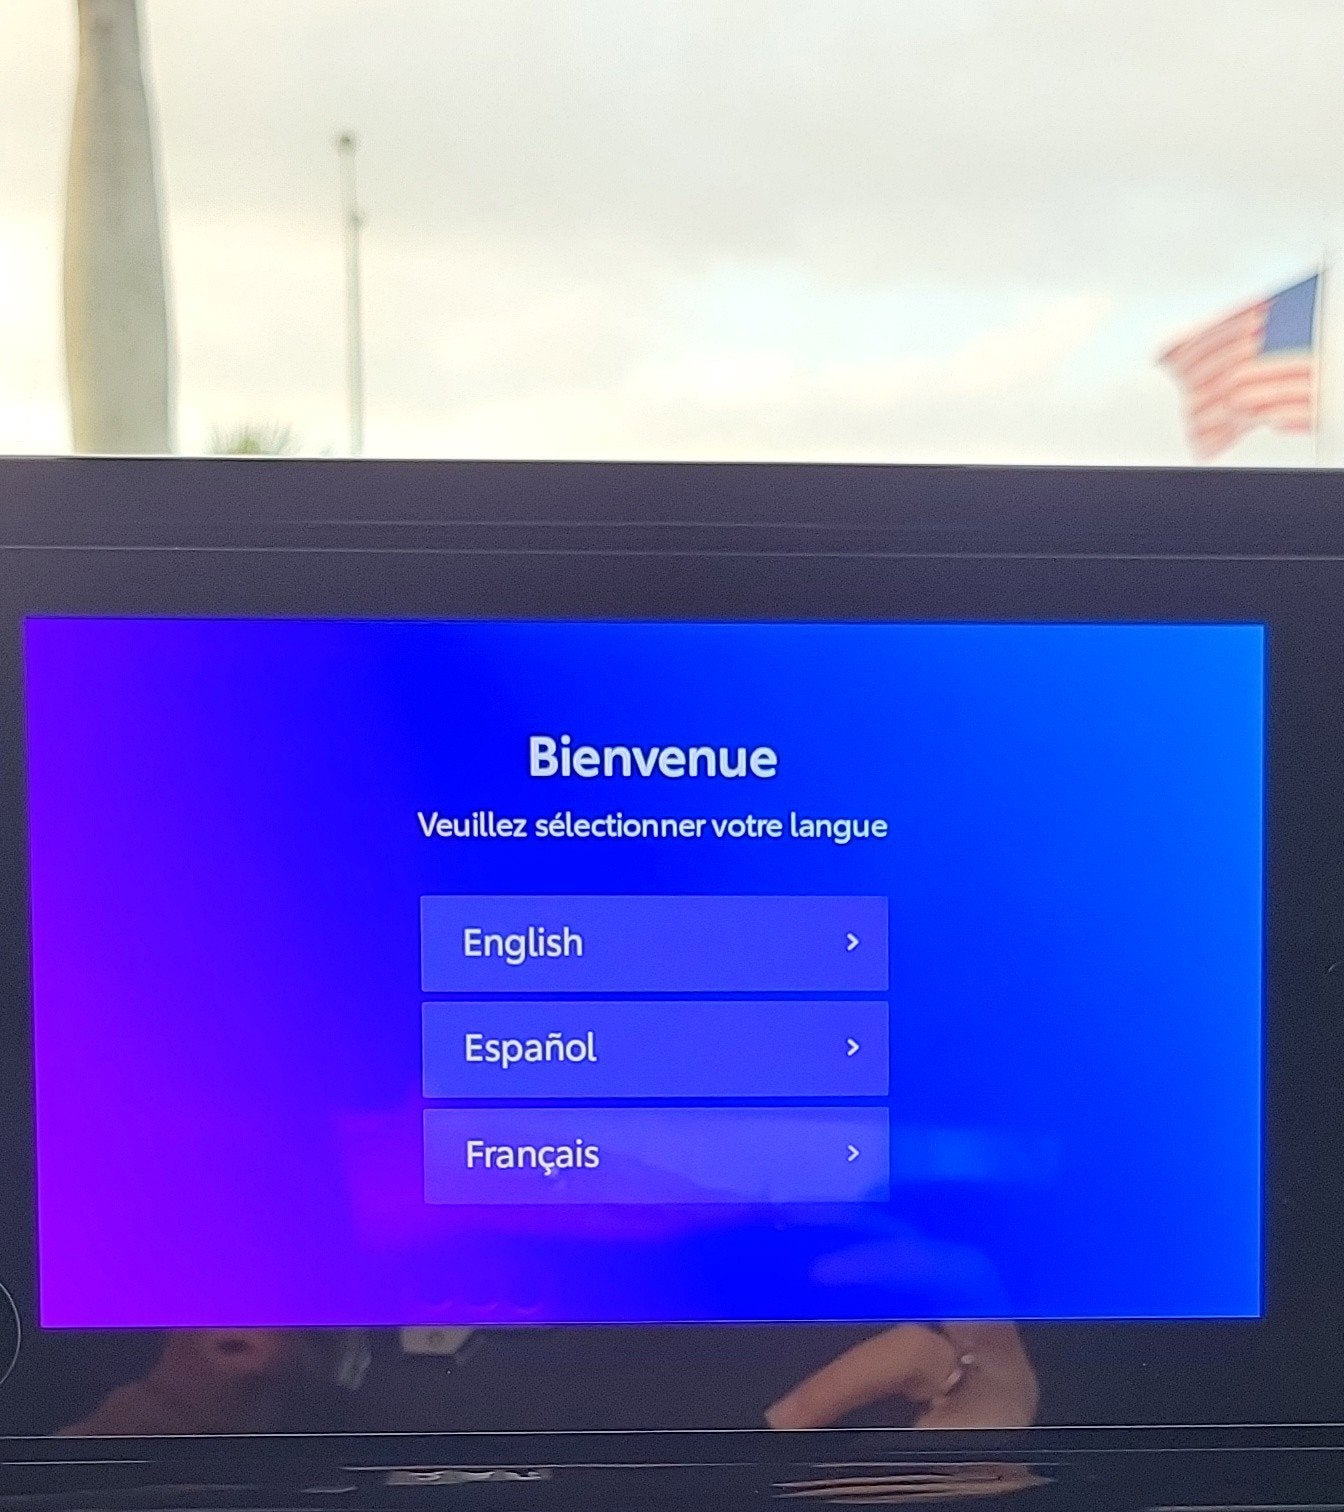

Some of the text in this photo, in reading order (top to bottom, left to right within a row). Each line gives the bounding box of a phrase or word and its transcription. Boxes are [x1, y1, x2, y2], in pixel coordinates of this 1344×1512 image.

[529, 734, 778, 778] Bienvenue
[417, 812, 888, 844] Veuillez sélectionner votre langue
[463, 927, 584, 964] English
[464, 1031, 597, 1068] Español
[466, 1139, 600, 1175] Français
